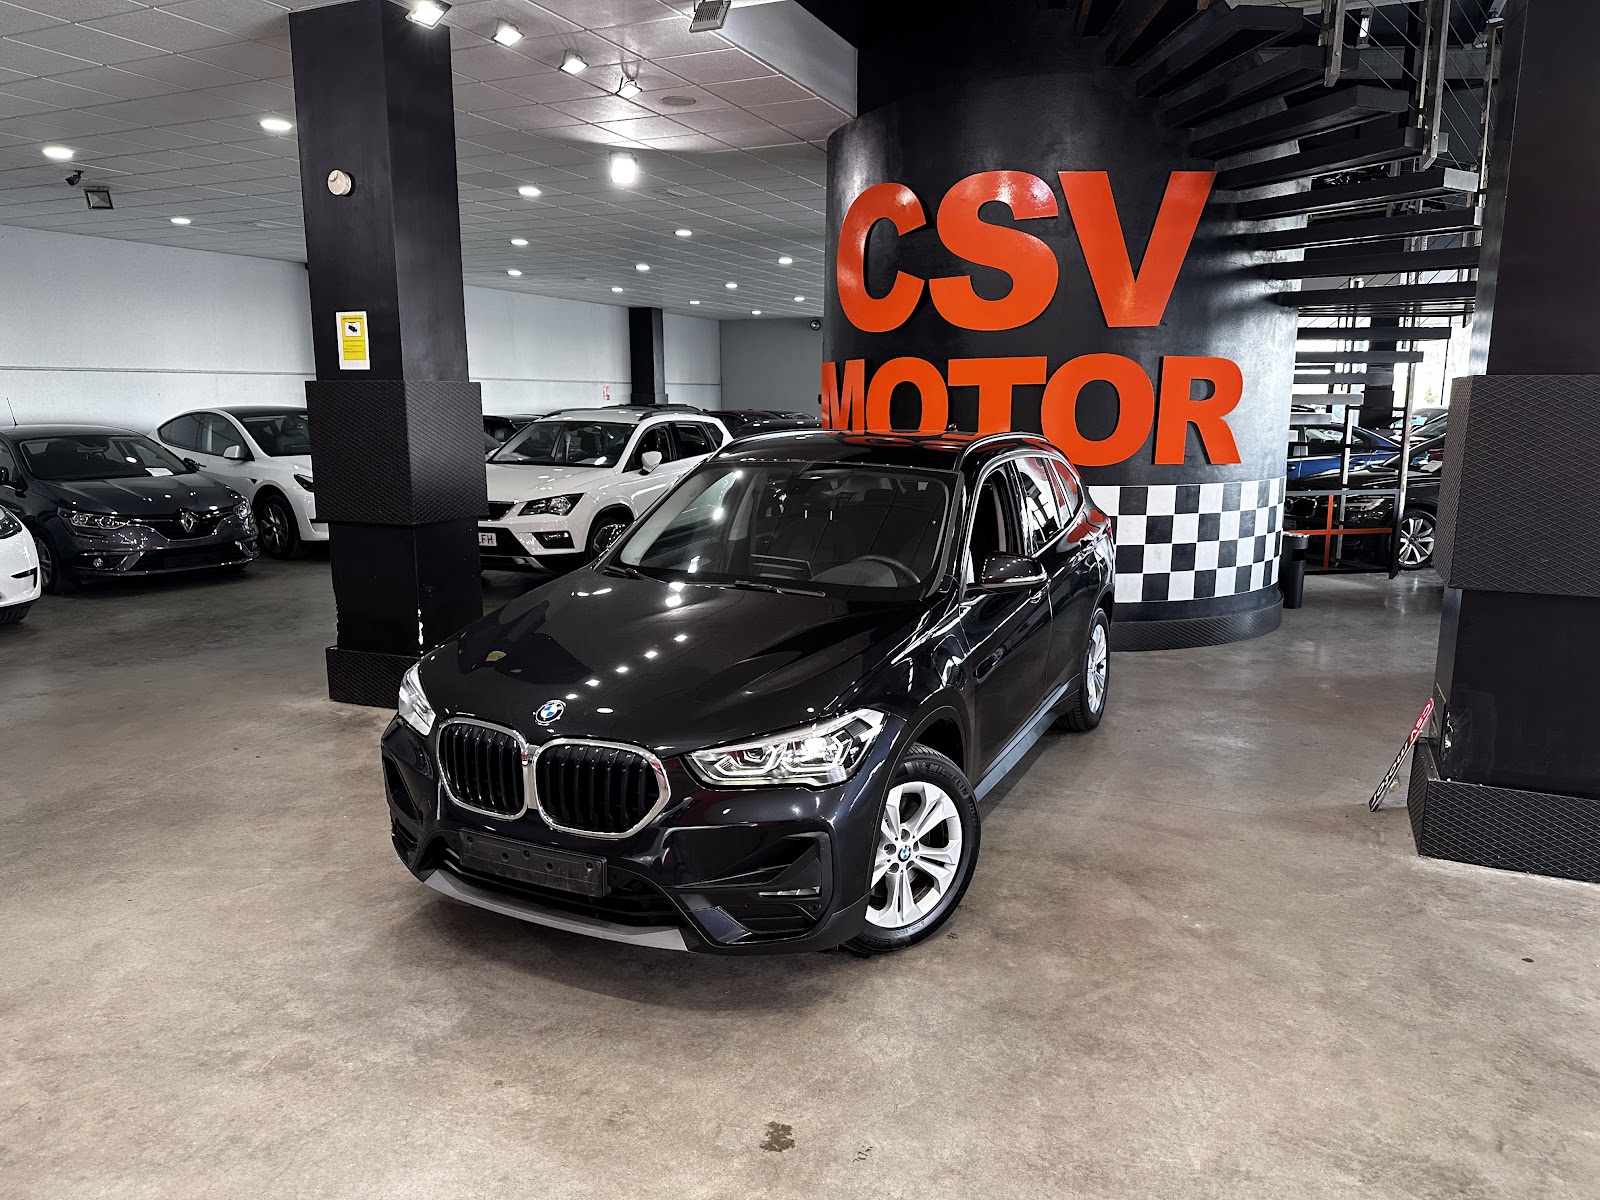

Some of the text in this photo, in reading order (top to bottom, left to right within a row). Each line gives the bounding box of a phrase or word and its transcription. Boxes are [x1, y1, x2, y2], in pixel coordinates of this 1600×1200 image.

[836, 170, 1217, 333] CSV
[821, 353, 1244, 466] MOTOR
[929, 763, 970, 797] MICHELIN
